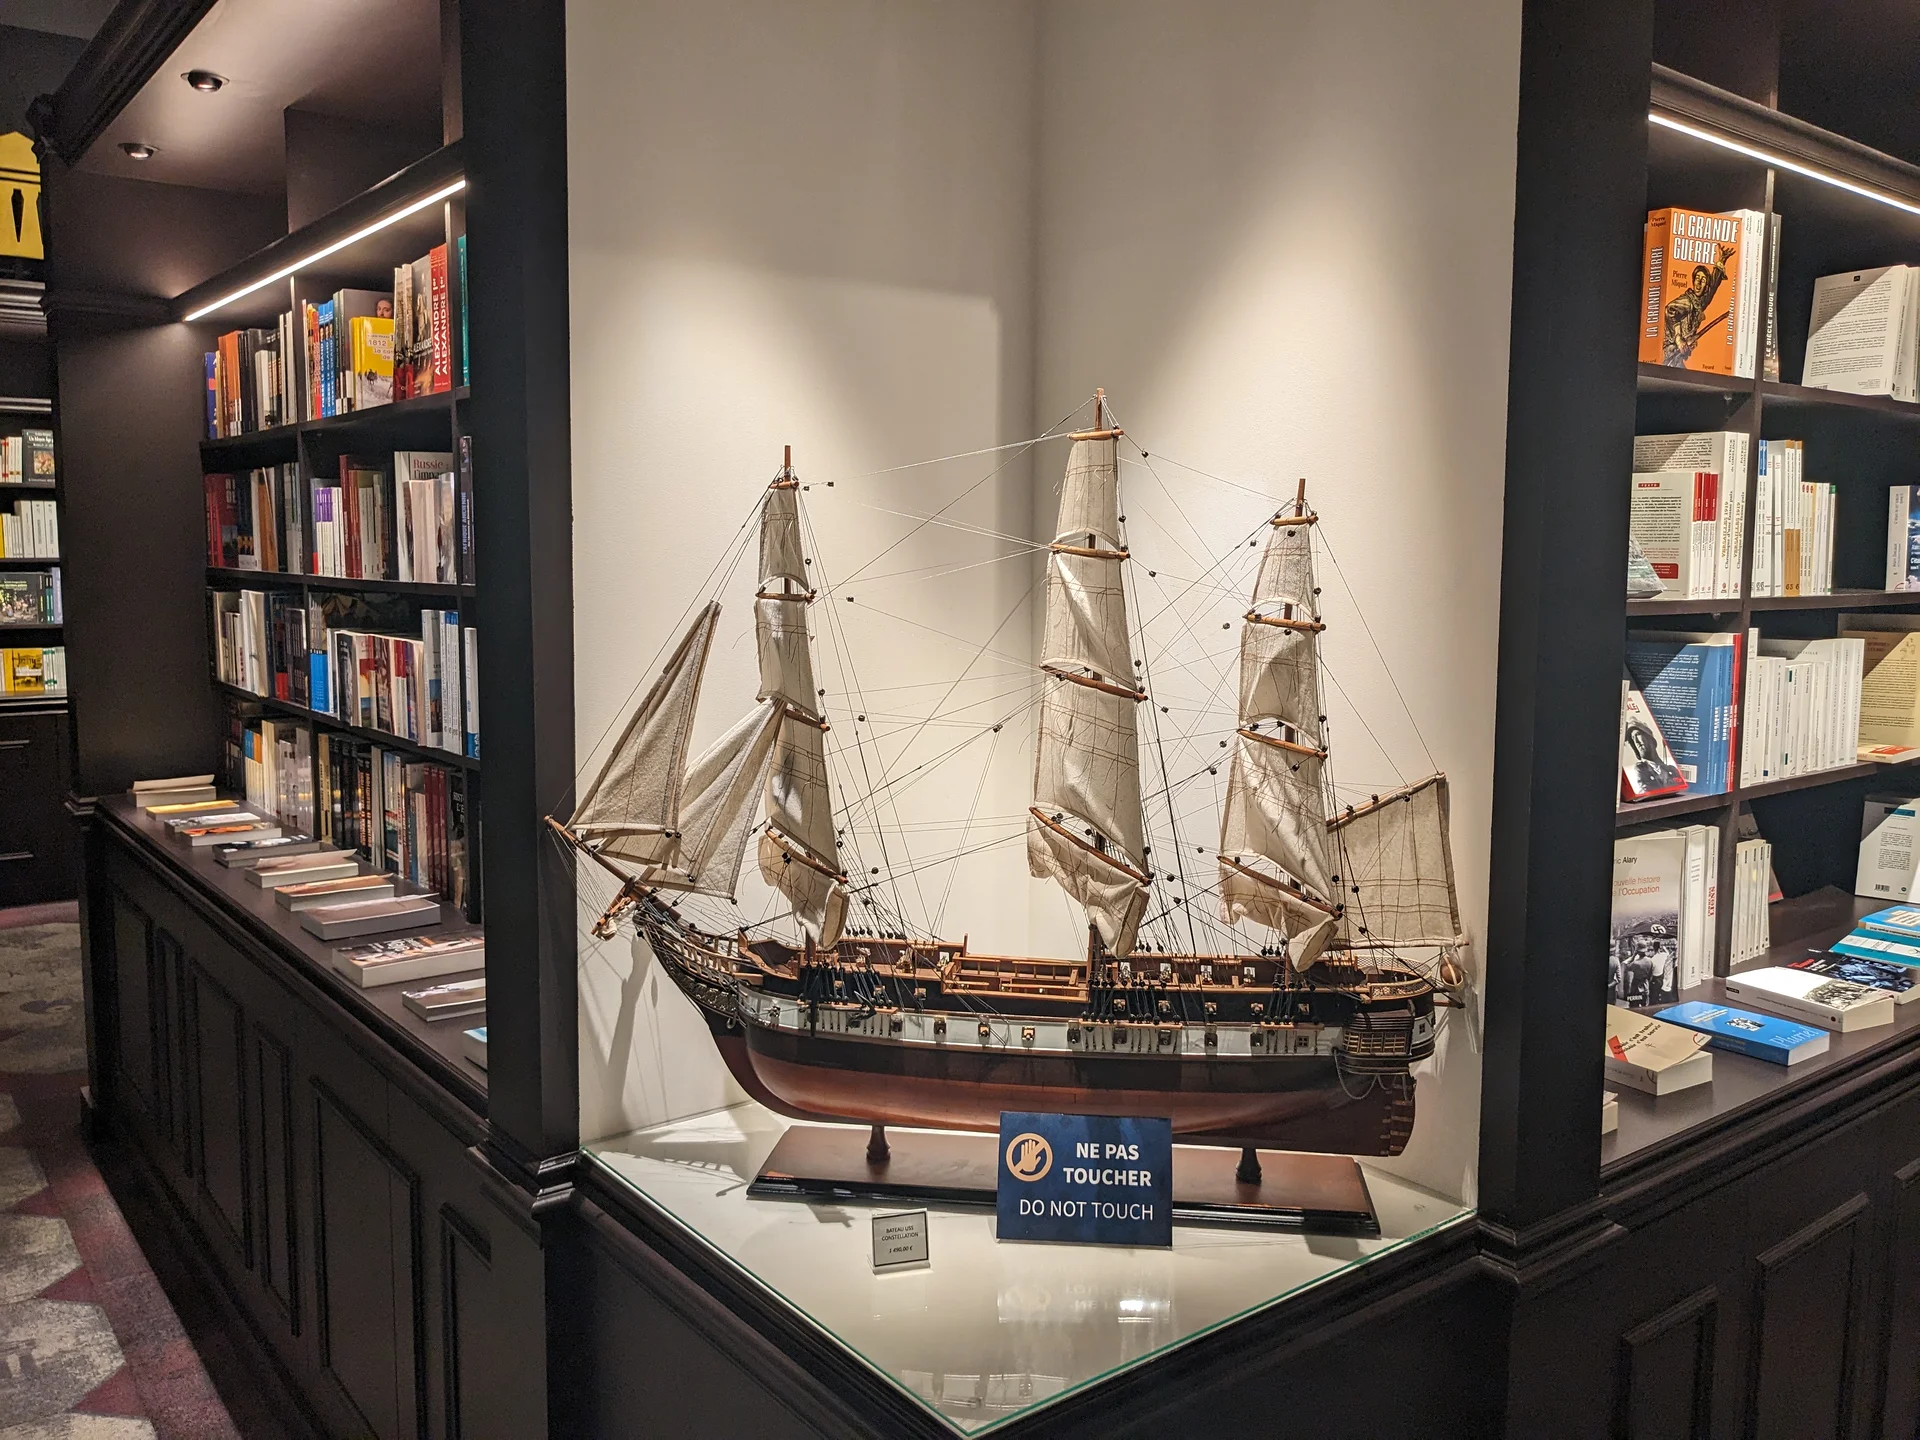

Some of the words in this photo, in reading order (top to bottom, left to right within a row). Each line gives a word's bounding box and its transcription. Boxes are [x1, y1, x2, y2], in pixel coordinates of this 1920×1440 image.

[1672, 212, 1685, 236] LA
[1688, 215, 1739, 243] GRANDE
[1673, 238, 1718, 264] GUERRE
[1650, 246, 1664, 282] GUERRE
[1672, 270, 1688, 279] Pierre
[1671, 279, 1688, 289] Miquel
[1646, 286, 1660, 323] GRANDE
[1646, 326, 1658, 338] LA
[1766, 347, 1771, 357] LE
[413, 459, 443, 469] Russie
[1613, 877, 1636, 887] ouvelle
[1638, 876, 1660, 884] histoire
[1618, 886, 1660, 896] l'Occupation
[1639, 1022, 1654, 1034] trahir
[1647, 1024, 1661, 1036] servir
[1076, 1142, 1100, 1158] NE
[1106, 1144, 1139, 1160] PAS
[1063, 1167, 1151, 1186] TOUCHER
[1020, 1199, 1044, 1216] DO
[1050, 1200, 1087, 1217] NOT
[1091, 1202, 1153, 1220] TOUCH
[882, 1232, 918, 1241] CONSTELLATION
